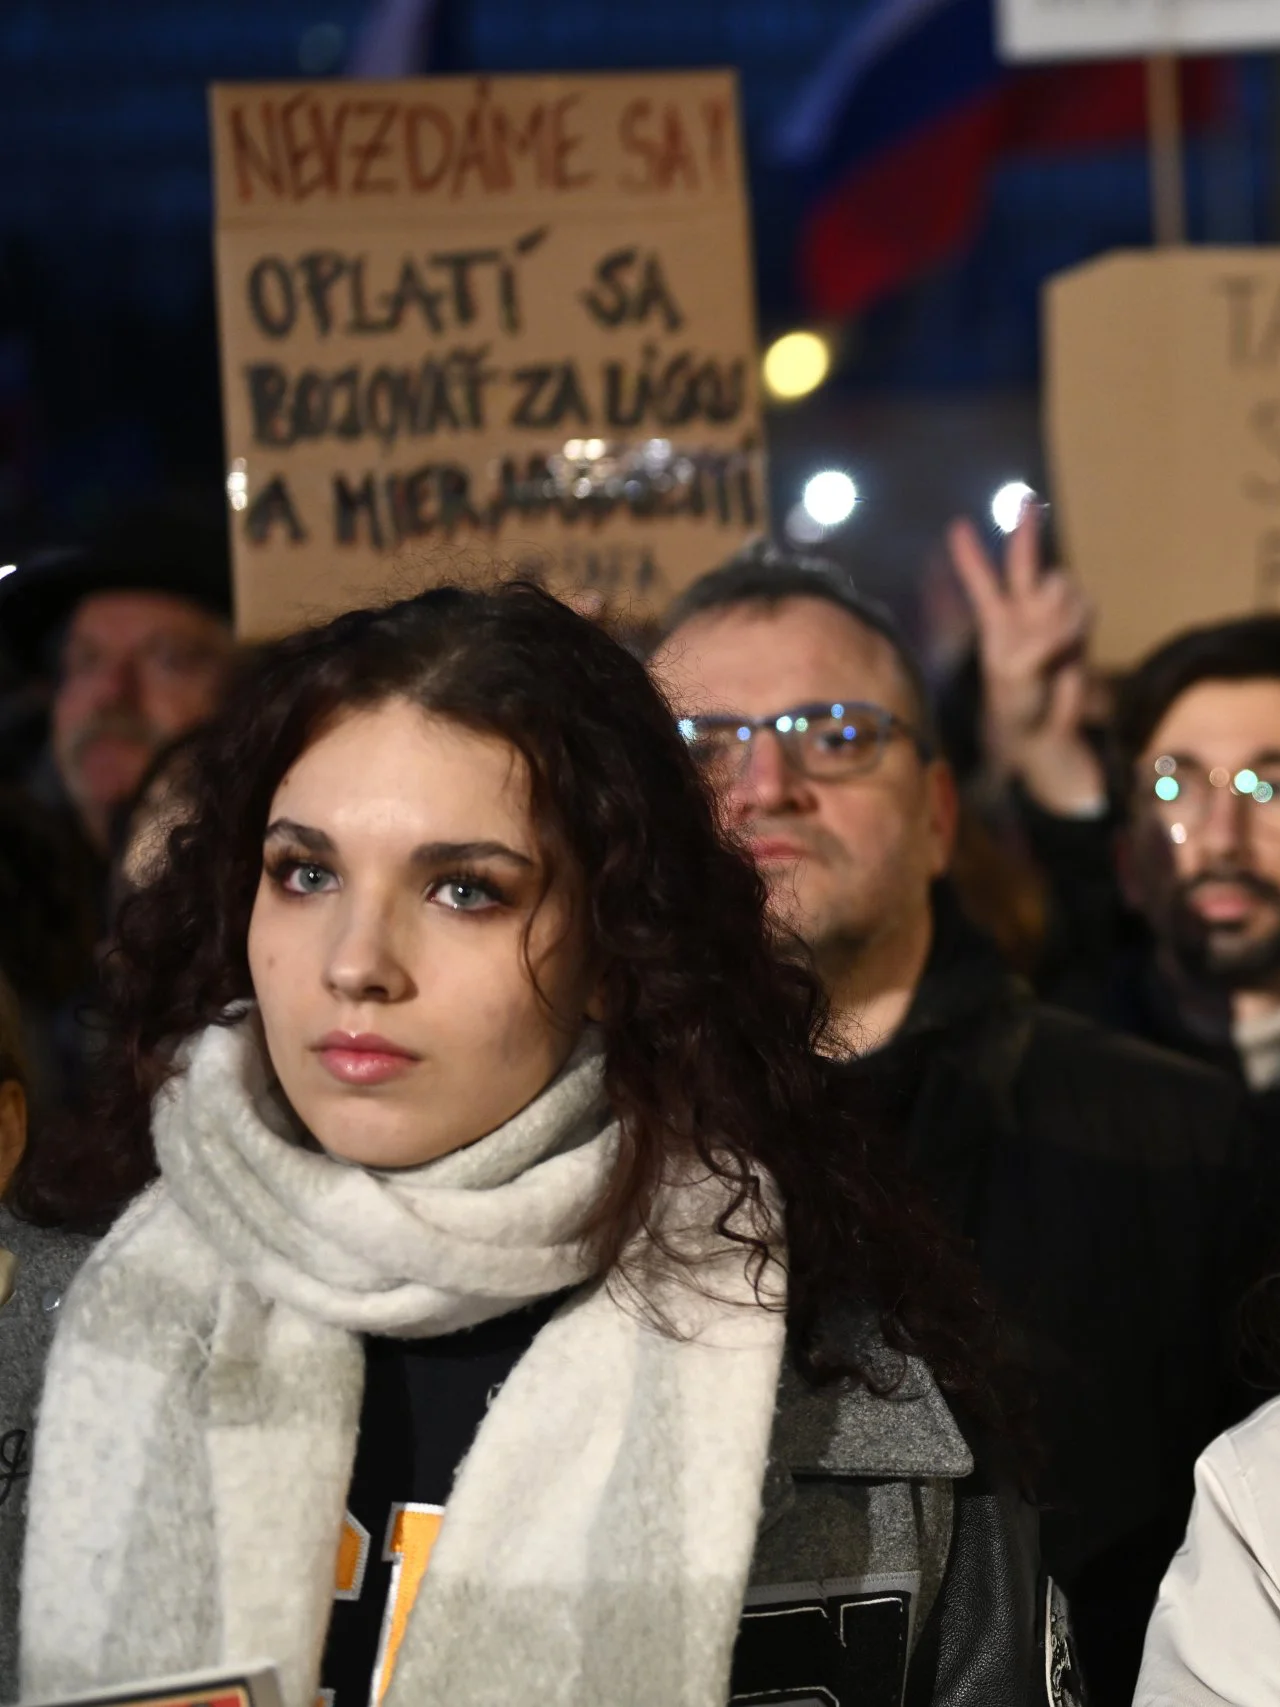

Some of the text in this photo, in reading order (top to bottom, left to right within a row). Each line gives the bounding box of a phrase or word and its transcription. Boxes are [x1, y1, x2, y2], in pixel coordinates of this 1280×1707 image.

[246, 228, 685, 340] OPLATÍ SA
[511, 357, 590, 431] ZA
[243, 470, 308, 550] A
